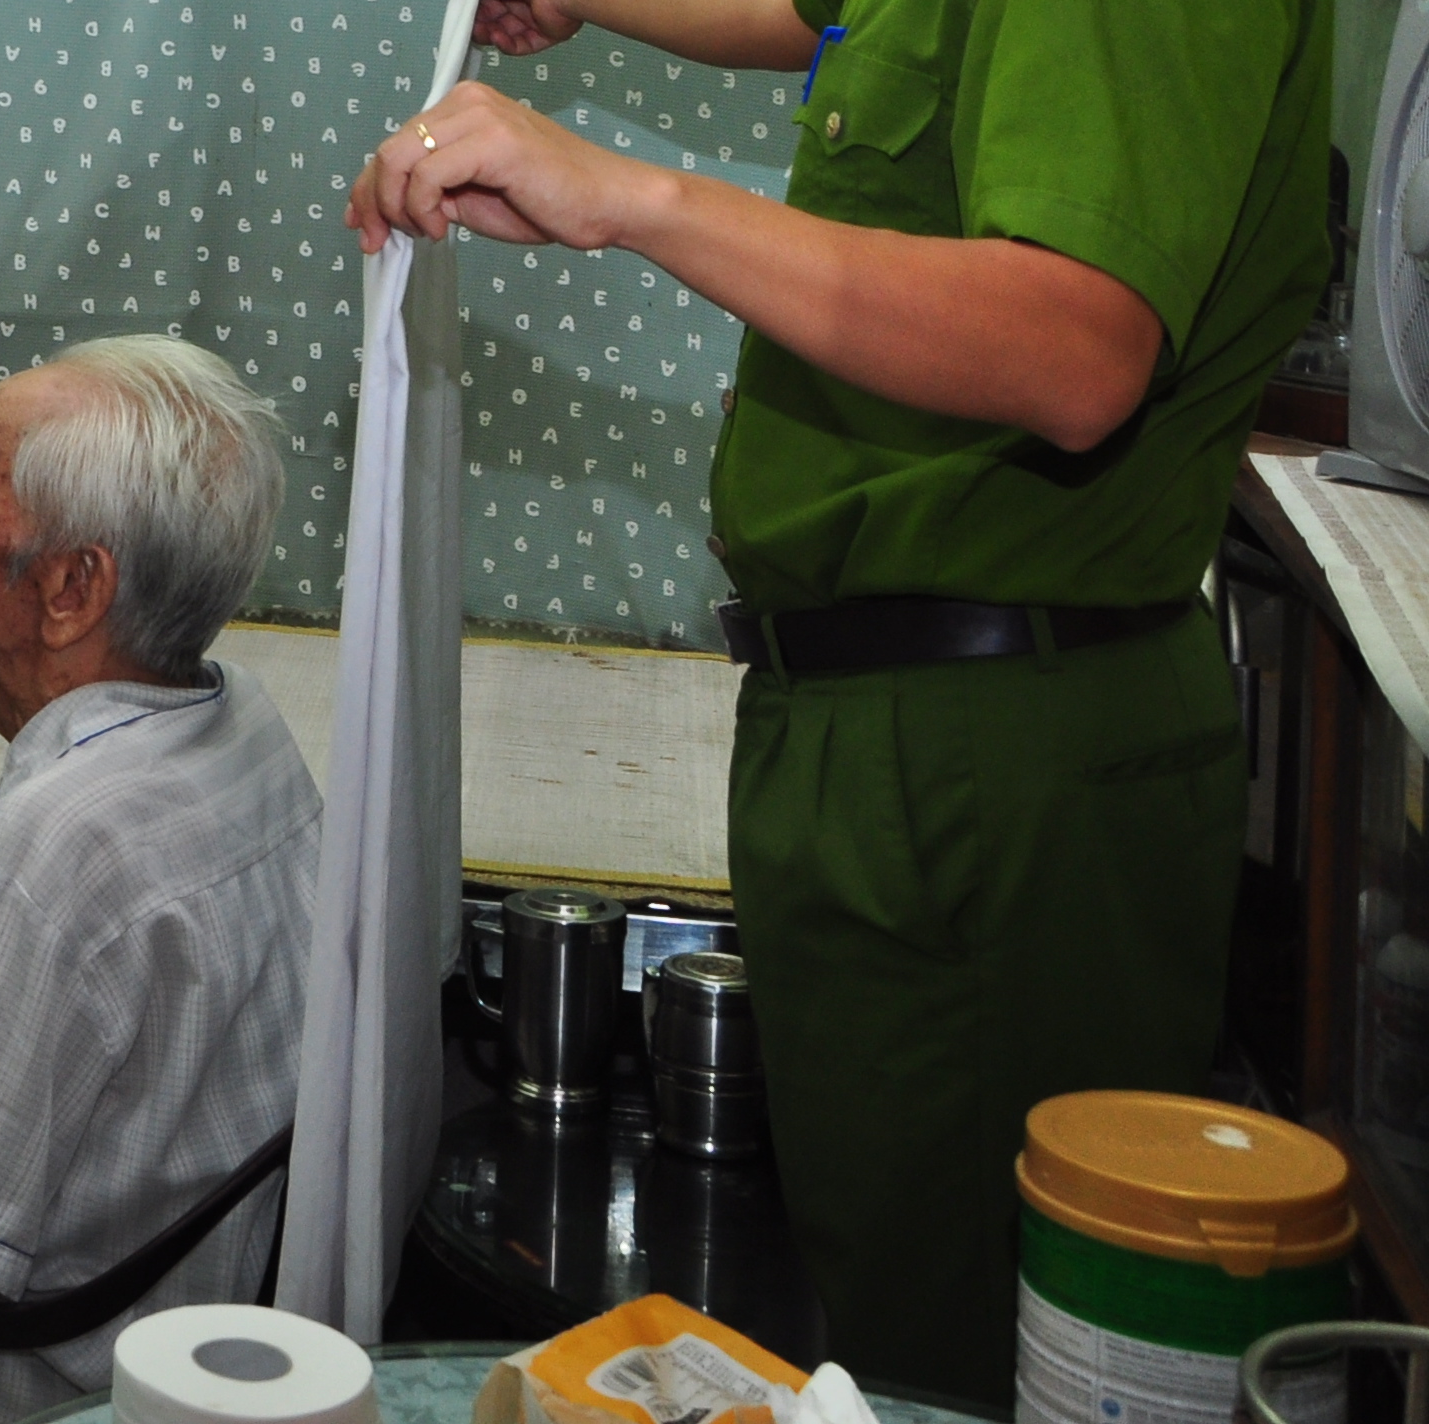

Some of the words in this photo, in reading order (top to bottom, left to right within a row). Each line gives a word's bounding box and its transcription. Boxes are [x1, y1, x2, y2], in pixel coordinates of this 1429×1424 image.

[29, 18, 41, 32] H
[234, 14, 246, 30] H
[332, 14, 347, 30] A
[379, 40, 393, 55] C
[178, 76, 192, 90] M
[347, 99, 359, 114] E
[20, 127, 32, 142] B
[322, 127, 337, 143] A
[149, 153, 160, 168] F
[6, 179, 21, 194] A
[217, 180, 232, 196] A
[95, 203, 109, 218] C
[155, 270, 167, 285] E
[687, 333, 701, 350] H
[605, 346, 620, 362] C
[620, 385, 637, 401] M
[570, 402, 582, 417] E
[542, 428, 557, 444] A
[674, 448, 687, 465] B
[585, 459, 597, 474] F
[656, 502, 672, 518] A
[663, 579, 675, 596] B
